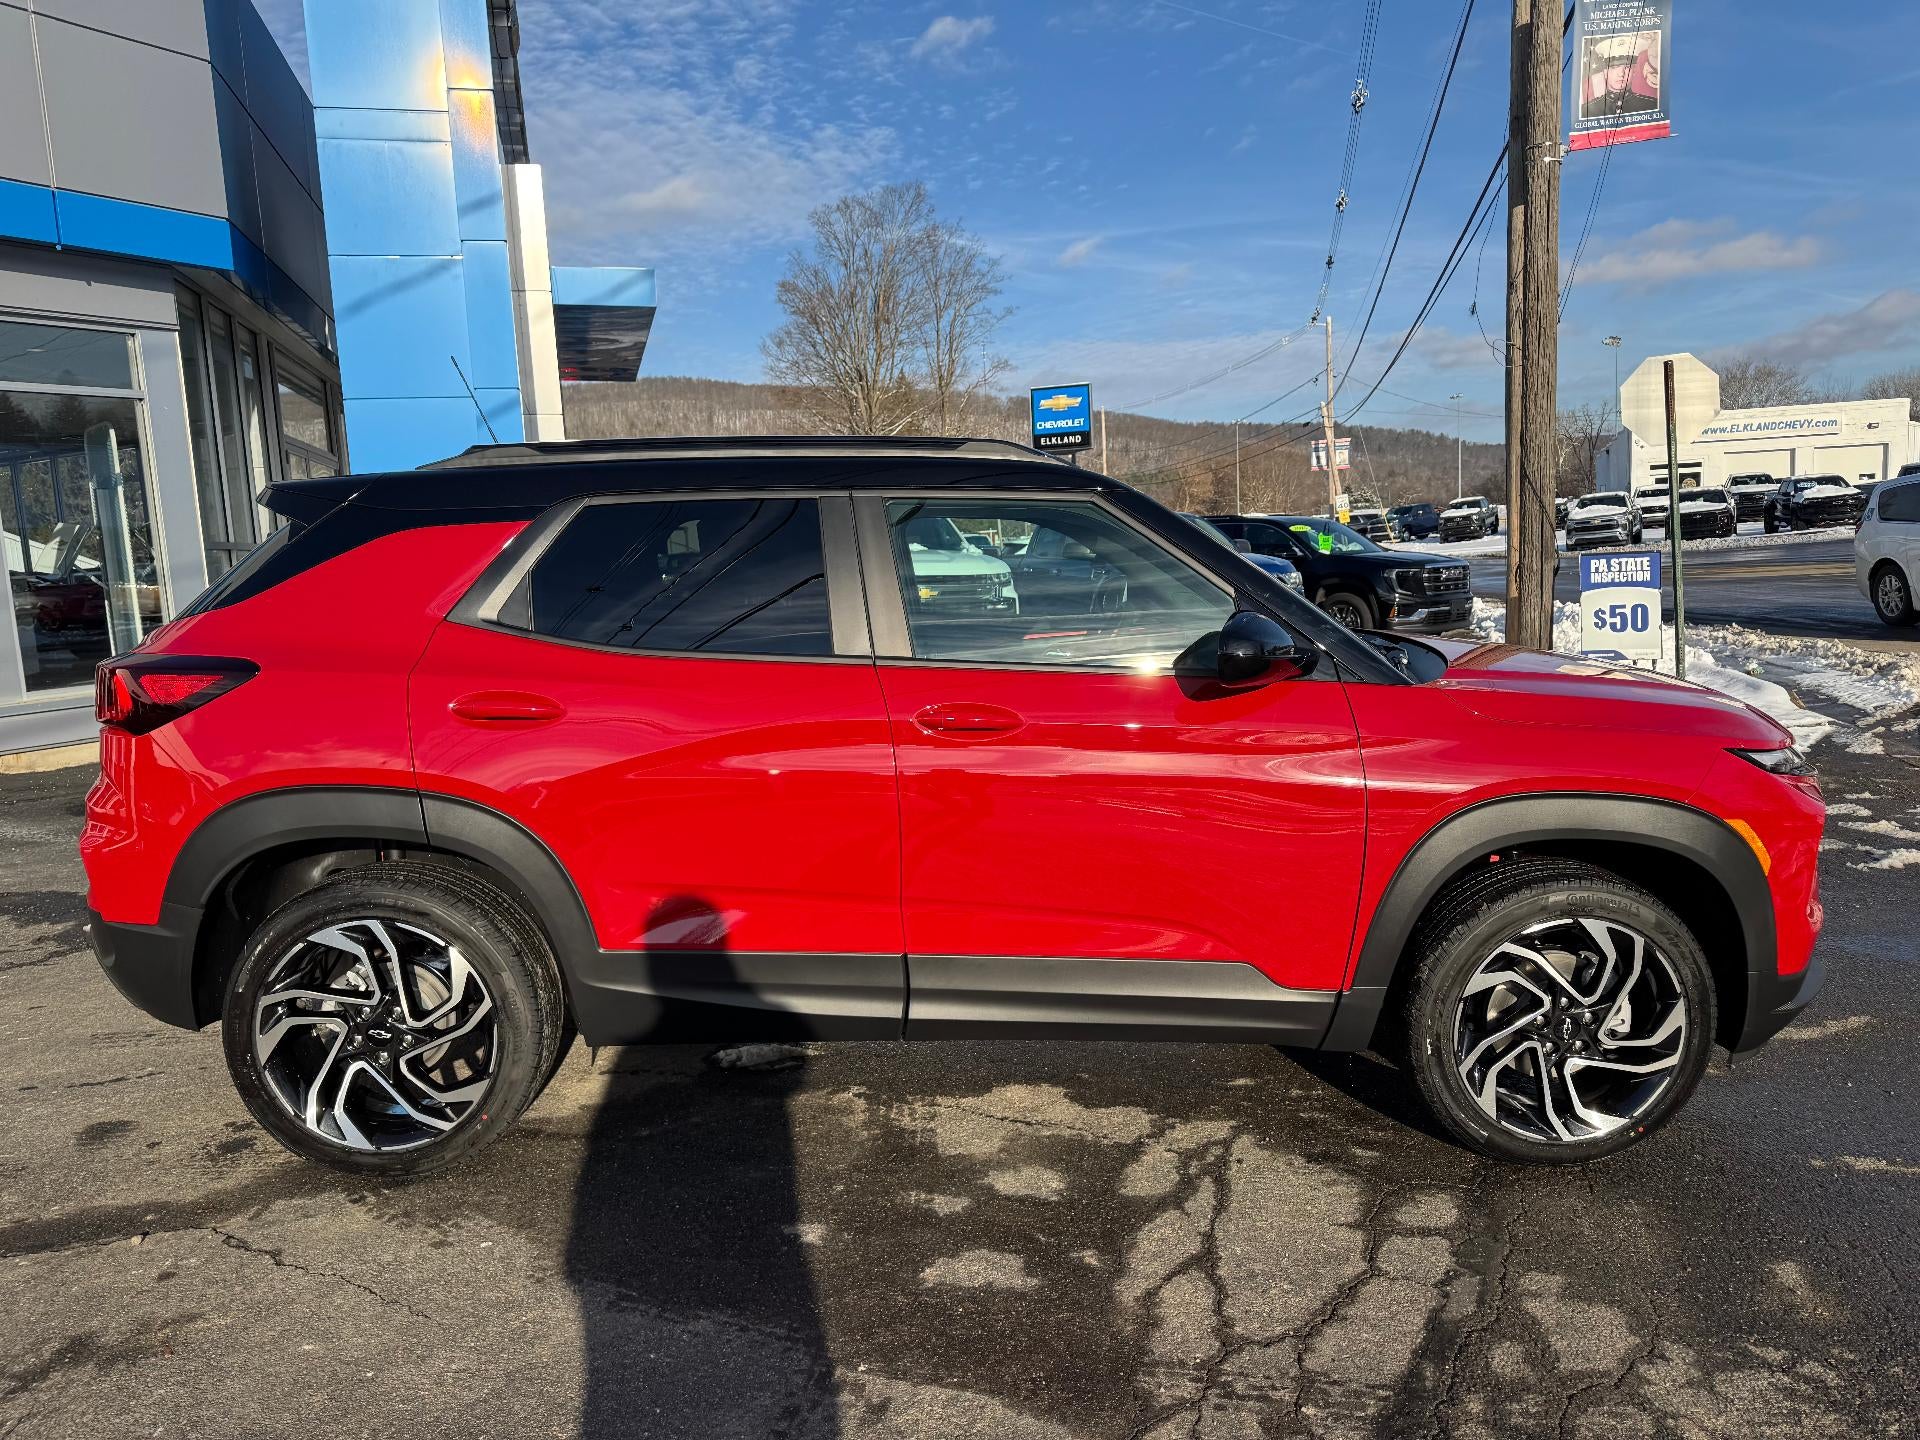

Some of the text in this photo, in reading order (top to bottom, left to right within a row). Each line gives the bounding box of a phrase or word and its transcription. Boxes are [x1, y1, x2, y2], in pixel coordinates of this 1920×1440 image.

[1590, 6, 1657, 20] MICHAEL PLANK
[1584, 16, 1661, 31] U.S. MARINE CORPS
[1574, 120, 1600, 129] GLOBAL
[1036, 418, 1085, 430] CHEVROLET
[1040, 435, 1082, 446] ELKLAND
[1590, 557, 1651, 573] PA STATE
[1590, 570, 1651, 583] INSPECTION
[1593, 603, 1650, 633] $50
